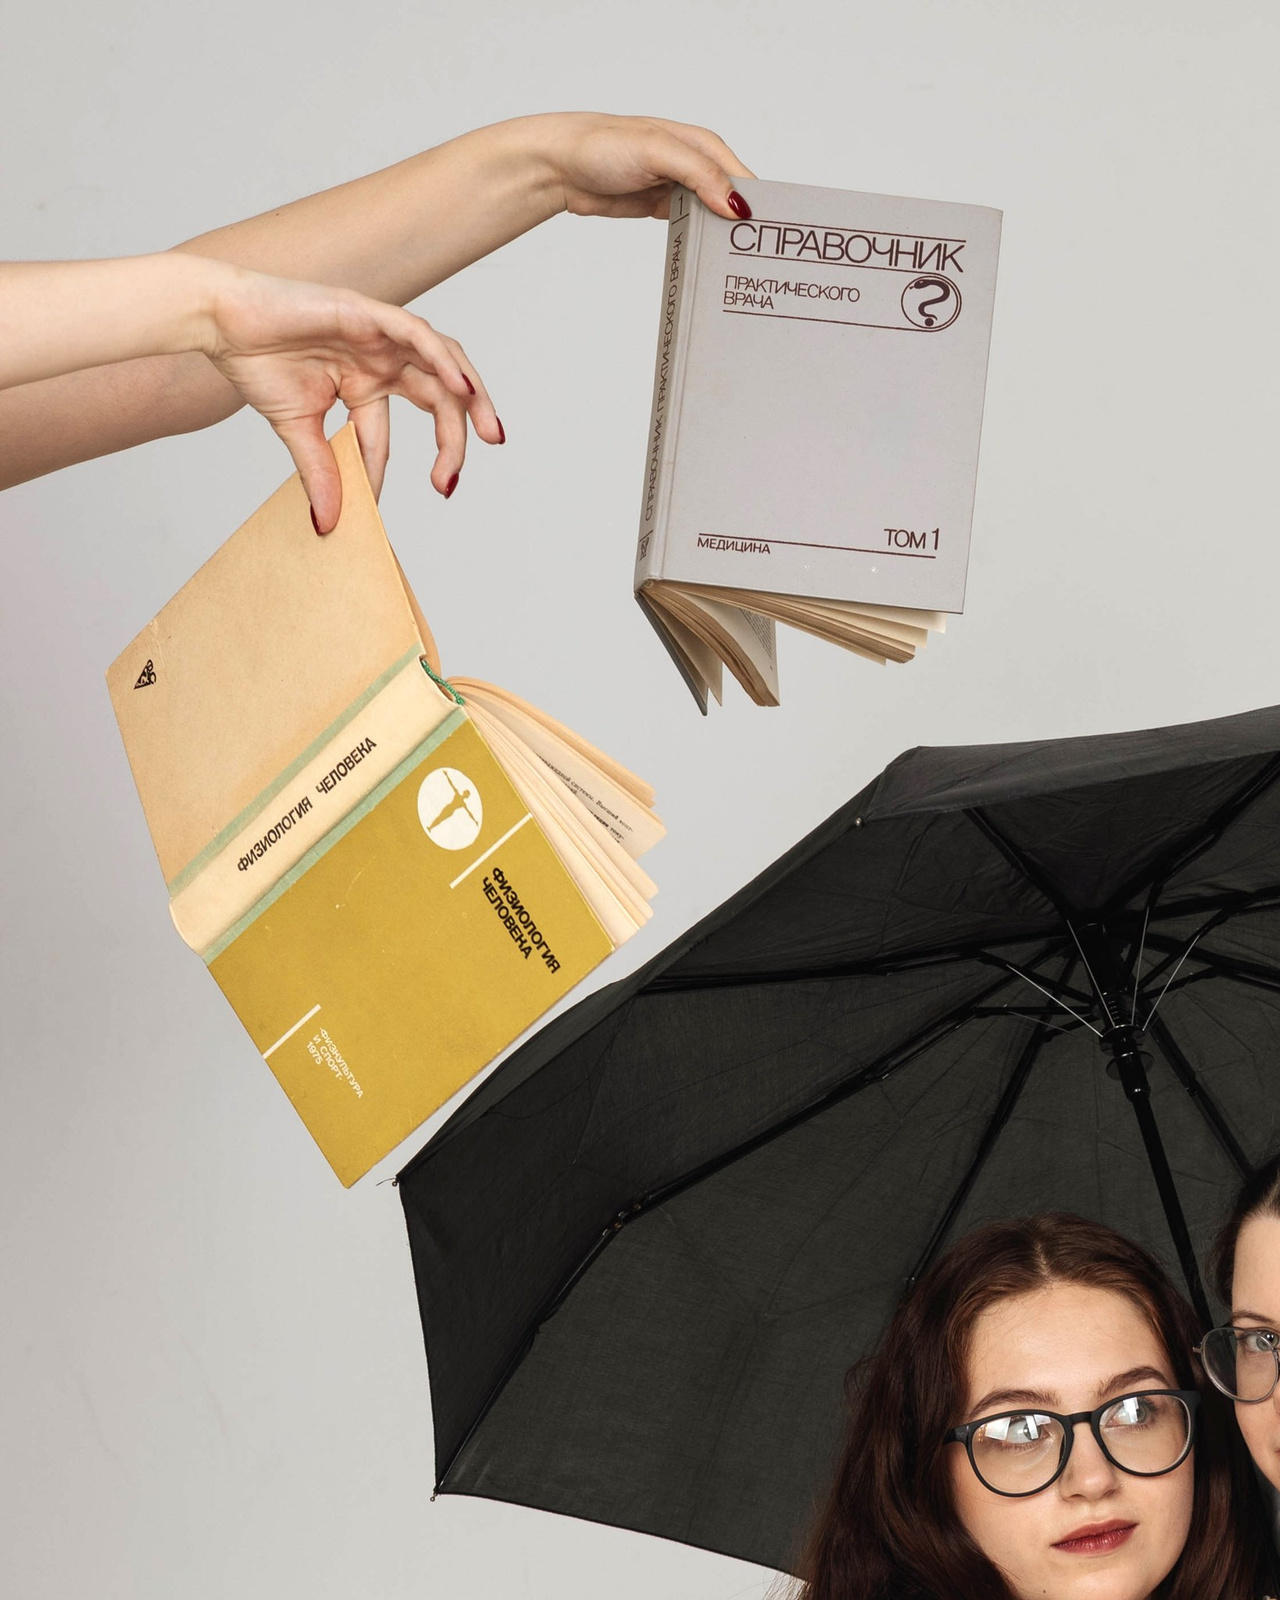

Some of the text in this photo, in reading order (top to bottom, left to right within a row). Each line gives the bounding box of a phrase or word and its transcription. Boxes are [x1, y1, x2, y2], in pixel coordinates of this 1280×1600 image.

[730, 220, 965, 273] СПРАВОЧНИК
[723, 290, 774, 310] ВРАЧА
[725, 274, 861, 303] ПРАКТИЧЕСКОГО
[645, 233, 683, 521] СПРАВОЧНИК ПРАКТИЧЕСКОГО ВРАЧА
[697, 537, 771, 555] МЕДИЦИНА
[884, 528, 940, 551] ТОМ 1
[237, 737, 377, 872] ФИЗИОЛОГИЯ ЧЕЛОВЕКА
[482, 876, 532, 960] ЧЕЛОВЕКА
[492, 868, 561, 974] ФИЗИОЛОГИЯ
[307, 1041, 324, 1065] 1975
[313, 1035, 322, 1044] И
